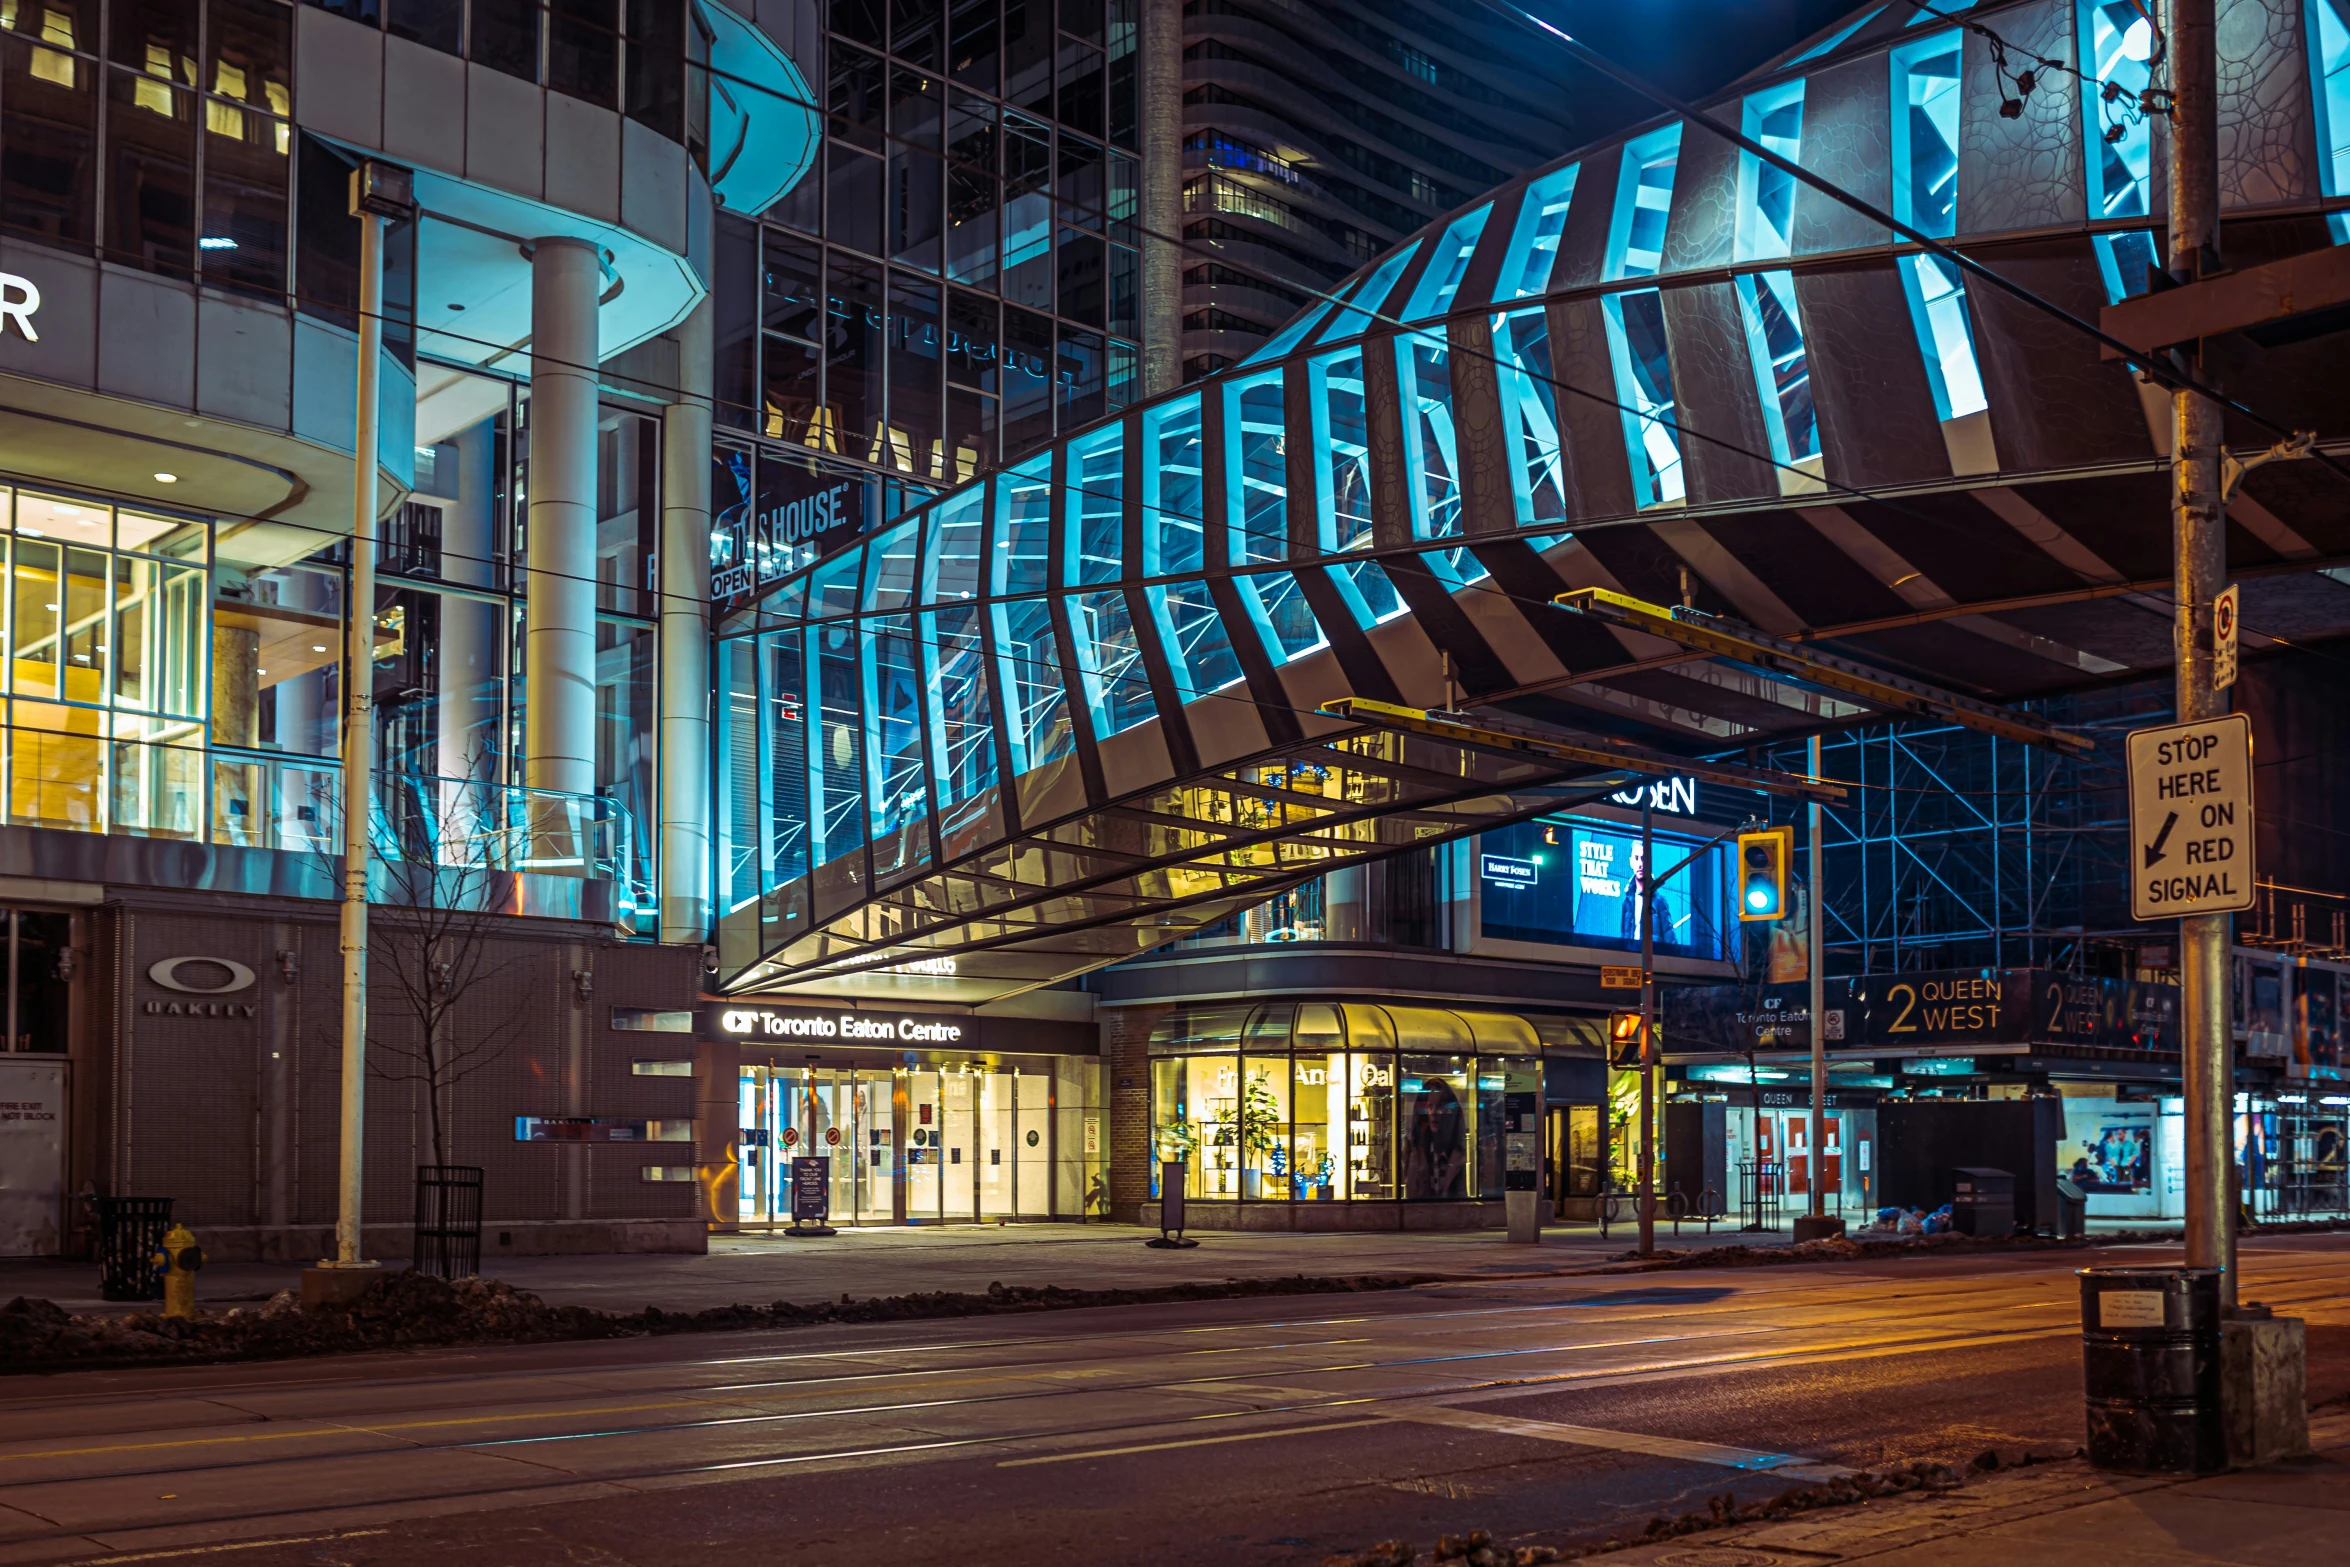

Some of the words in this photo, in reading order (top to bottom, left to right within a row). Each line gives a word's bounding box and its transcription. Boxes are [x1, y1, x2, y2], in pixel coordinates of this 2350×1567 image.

[712, 568, 750, 597] OPEN
[2157, 734, 2219, 766] STOP
[2158, 769, 2221, 800] HERE
[2200, 802, 2234, 829] ON
[1579, 840, 1614, 862] STYLE
[2186, 838, 2234, 865] RED
[1580, 859, 1610, 878] THAT
[1580, 877, 1621, 898] WORKS
[2149, 873, 2238, 904] SIGNAL
[145, 1001, 256, 1017] OAKLEY
[1764, 998, 1782, 1010] CF
[1887, 984, 1918, 1033] 2
[1922, 979, 2002, 1001] QUEEN
[2046, 982, 2064, 1033] 2
[2065, 984, 2103, 1006] QUEEN
[759, 1012, 837, 1037] Toronto
[839, 1016, 895, 1039] Eaton
[898, 1018, 962, 1042] Centre
[1736, 1012, 1777, 1024] Toronto
[1922, 1004, 2002, 1031] WEST
[2064, 1010, 2103, 1035] WEST
[1755, 1026, 1792, 1037] Centre
[21, 1102, 43, 1111] EXIT
[1763, 1093, 1793, 1105] QUEEN
[1808, 1093, 1838, 1106] SEET
[2, 1112, 21, 1121] NOT
[24, 1112, 56, 1121] BLOCK
